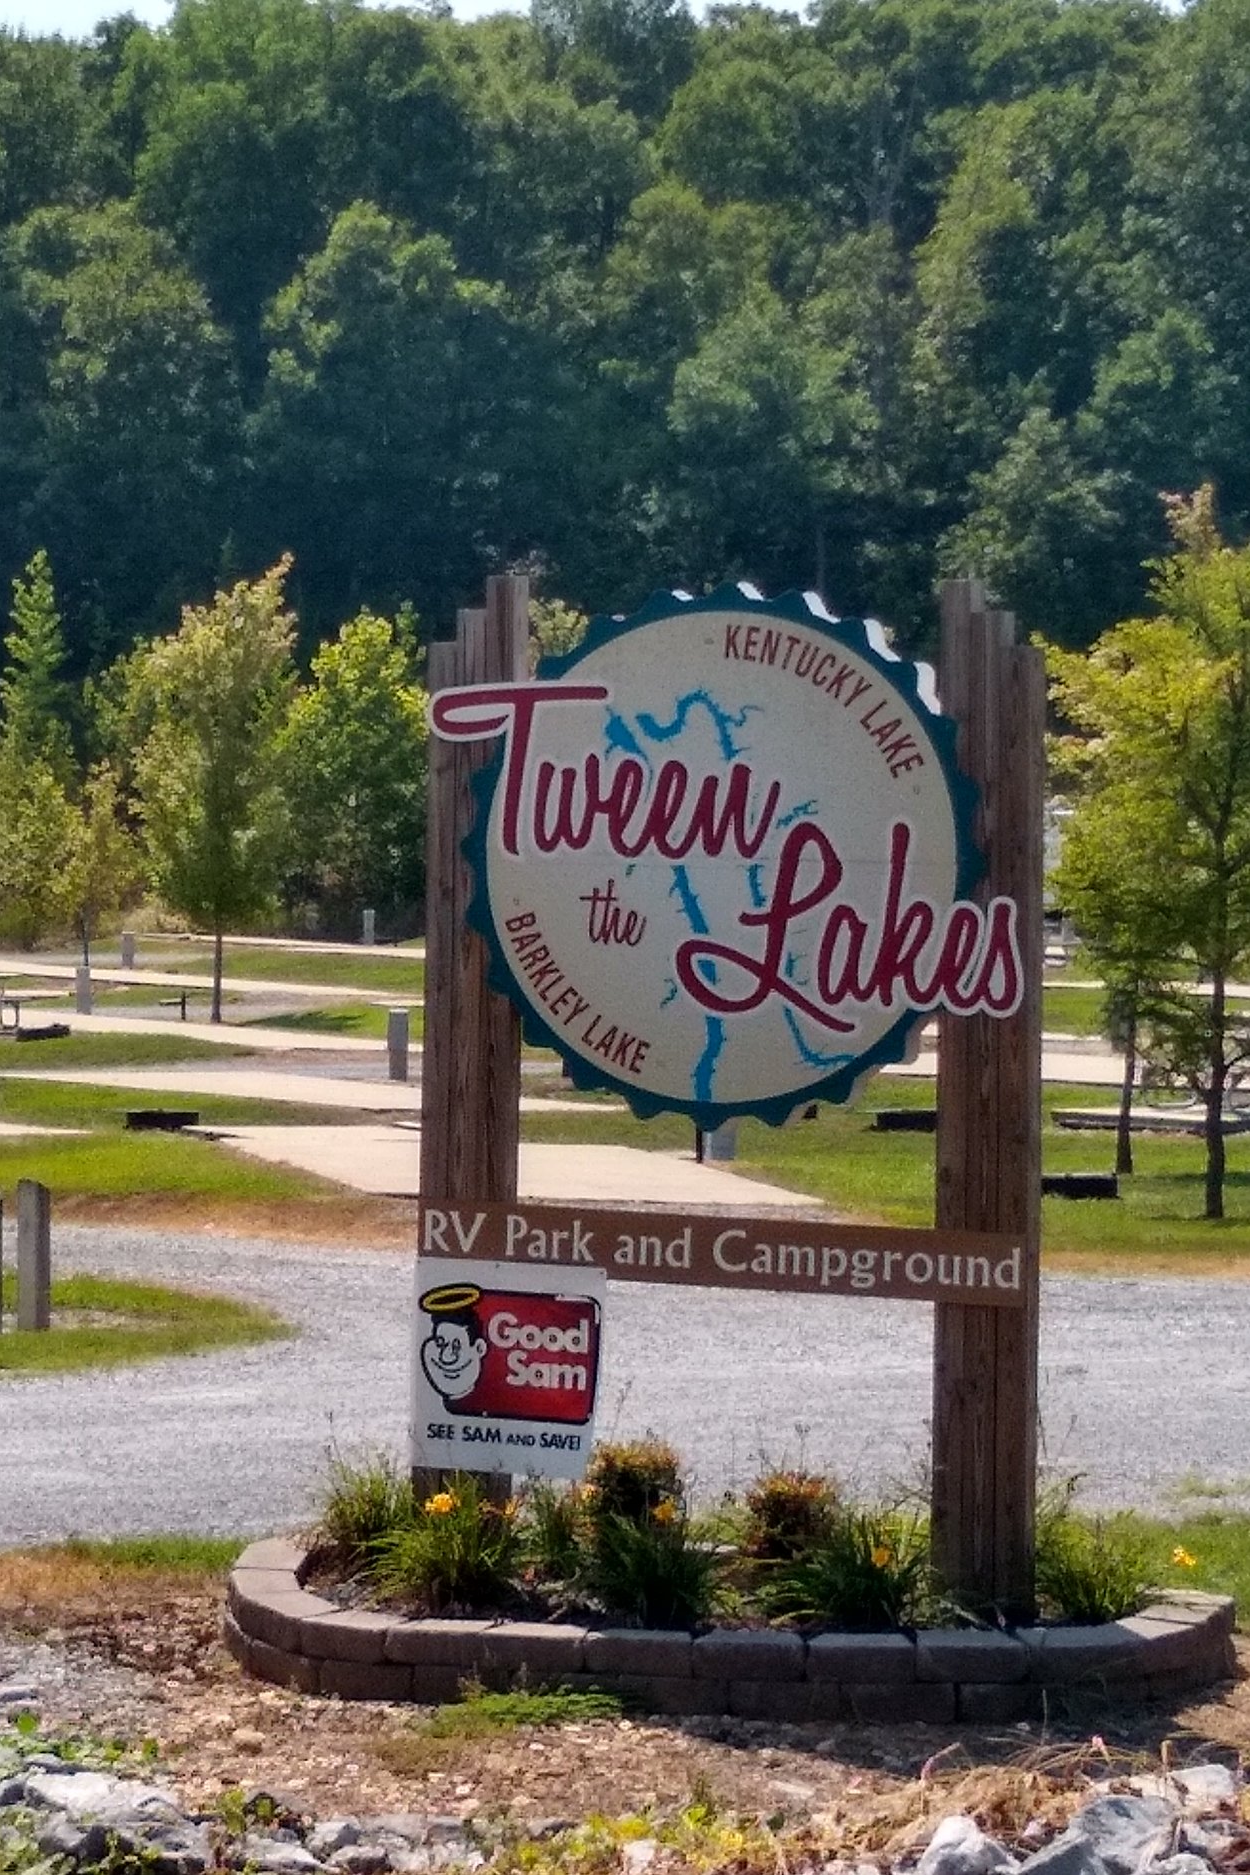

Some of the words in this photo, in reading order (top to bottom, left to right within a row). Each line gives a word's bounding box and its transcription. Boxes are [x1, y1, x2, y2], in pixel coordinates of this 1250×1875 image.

[725, 624, 872, 707] KENTUCKY
[858, 701, 924, 781] LAKE
[432, 685, 781, 859] Tween
[579, 878, 647, 947] the
[675, 821, 1020, 1032] Lakes
[504, 912, 585, 1028] BARKLEY
[581, 1014, 651, 1076] LAKE
[423, 1208, 487, 1254] RV
[505, 1214, 596, 1263] Park
[614, 1223, 691, 1269] and
[712, 1228, 1022, 1291] Campground
[487, 1312, 589, 1355] Good
[505, 1350, 587, 1392] Sam
[426, 1423, 456, 1441] SEE
[461, 1426, 502, 1445] SAM
[506, 1434, 536, 1448] AND
